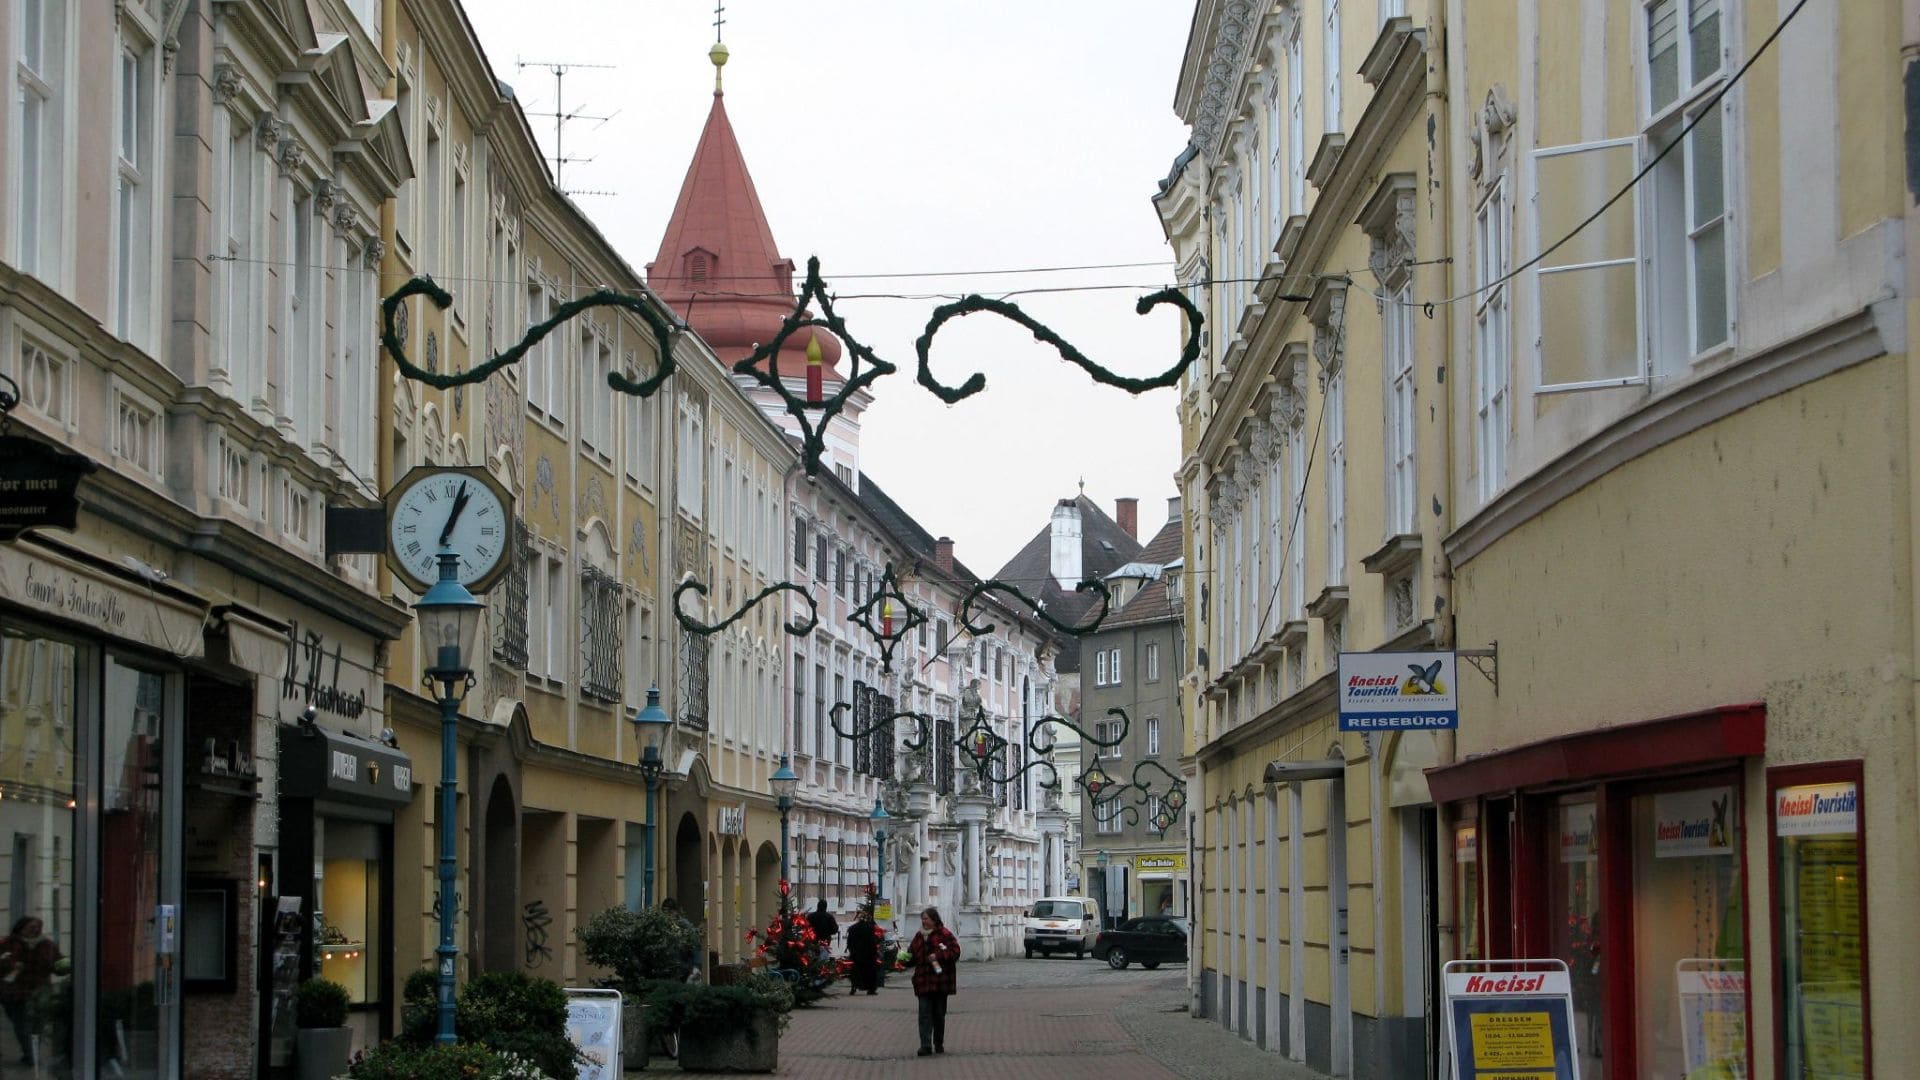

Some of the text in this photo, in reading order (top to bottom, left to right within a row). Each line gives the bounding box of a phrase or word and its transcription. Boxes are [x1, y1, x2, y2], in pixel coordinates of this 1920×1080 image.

[1347, 675, 1399, 687] Kneissl
[1347, 686, 1400, 697] Touristik
[1347, 715, 1450, 727] REISEBÜRO
[1465, 974, 1545, 993] Kneissl
